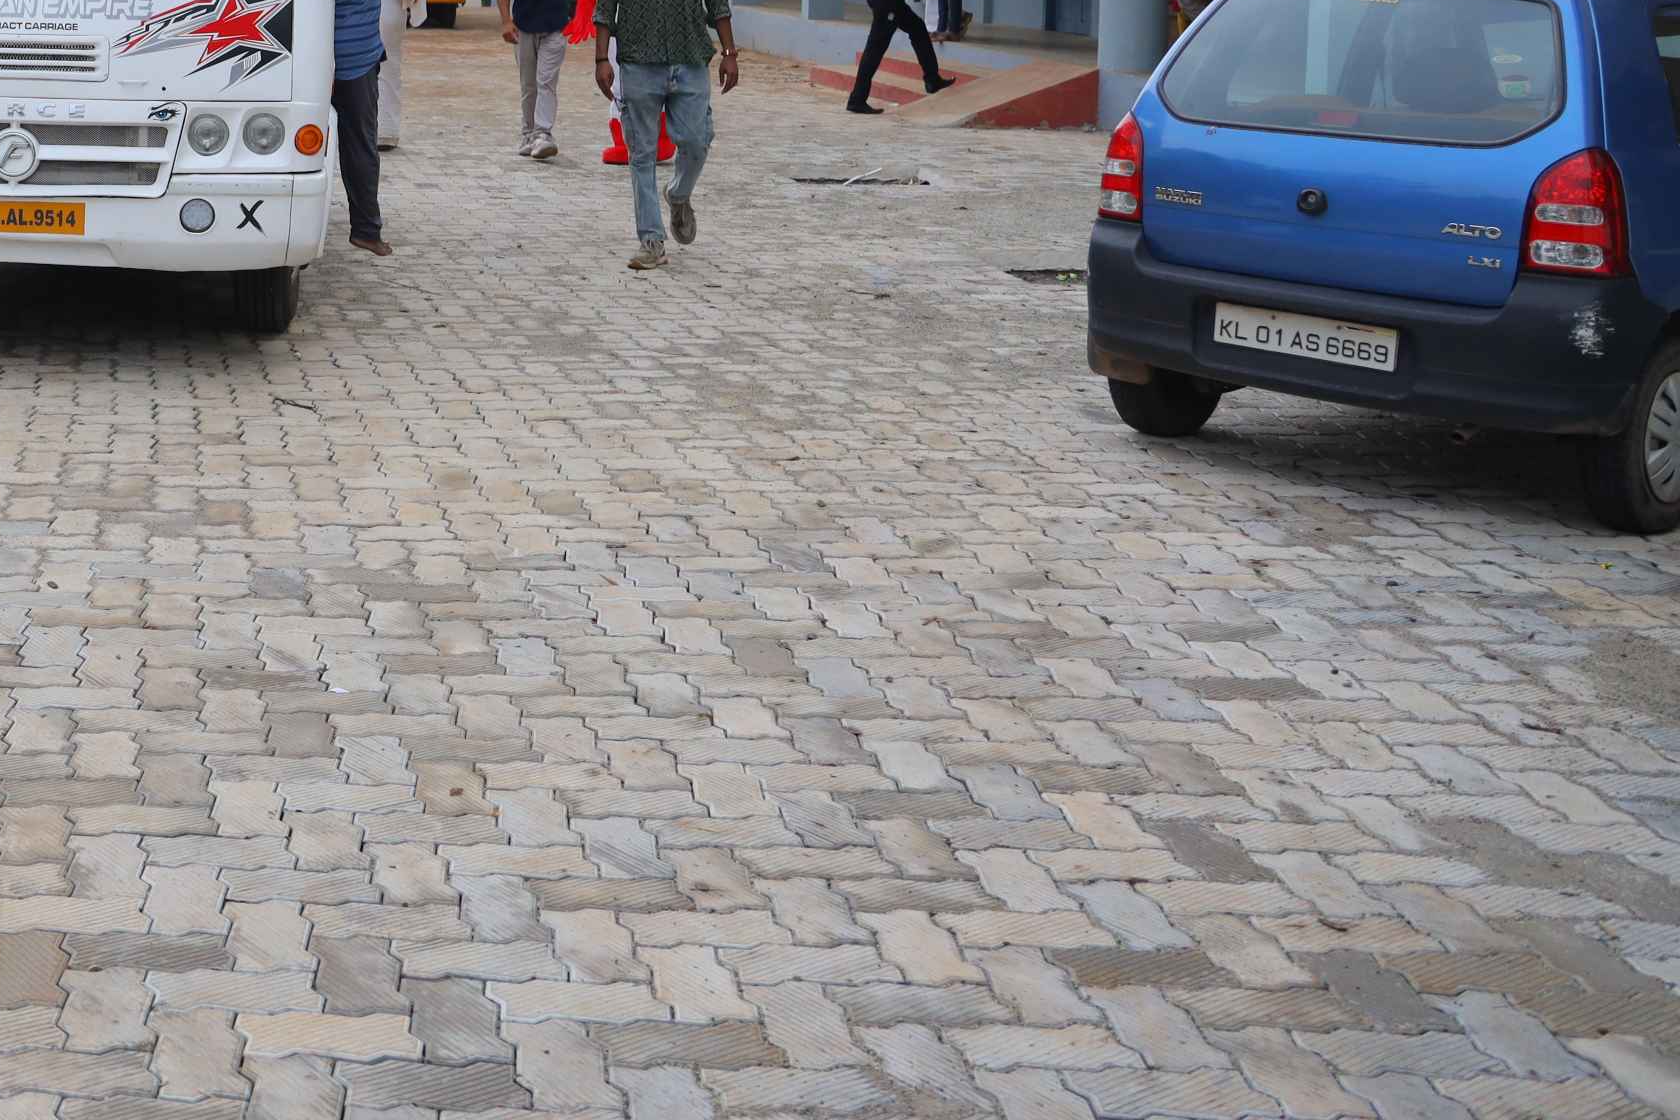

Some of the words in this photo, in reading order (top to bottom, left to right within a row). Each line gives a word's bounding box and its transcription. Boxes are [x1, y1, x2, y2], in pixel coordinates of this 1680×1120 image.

[24, 21, 79, 31] CARRIAGE
[1441, 222, 1503, 240] ALTO
[1219, 319, 1248, 341] KL
[1256, 325, 1283, 347] 01
[1290, 331, 1320, 352] AS
[1325, 336, 1389, 364] 6669
